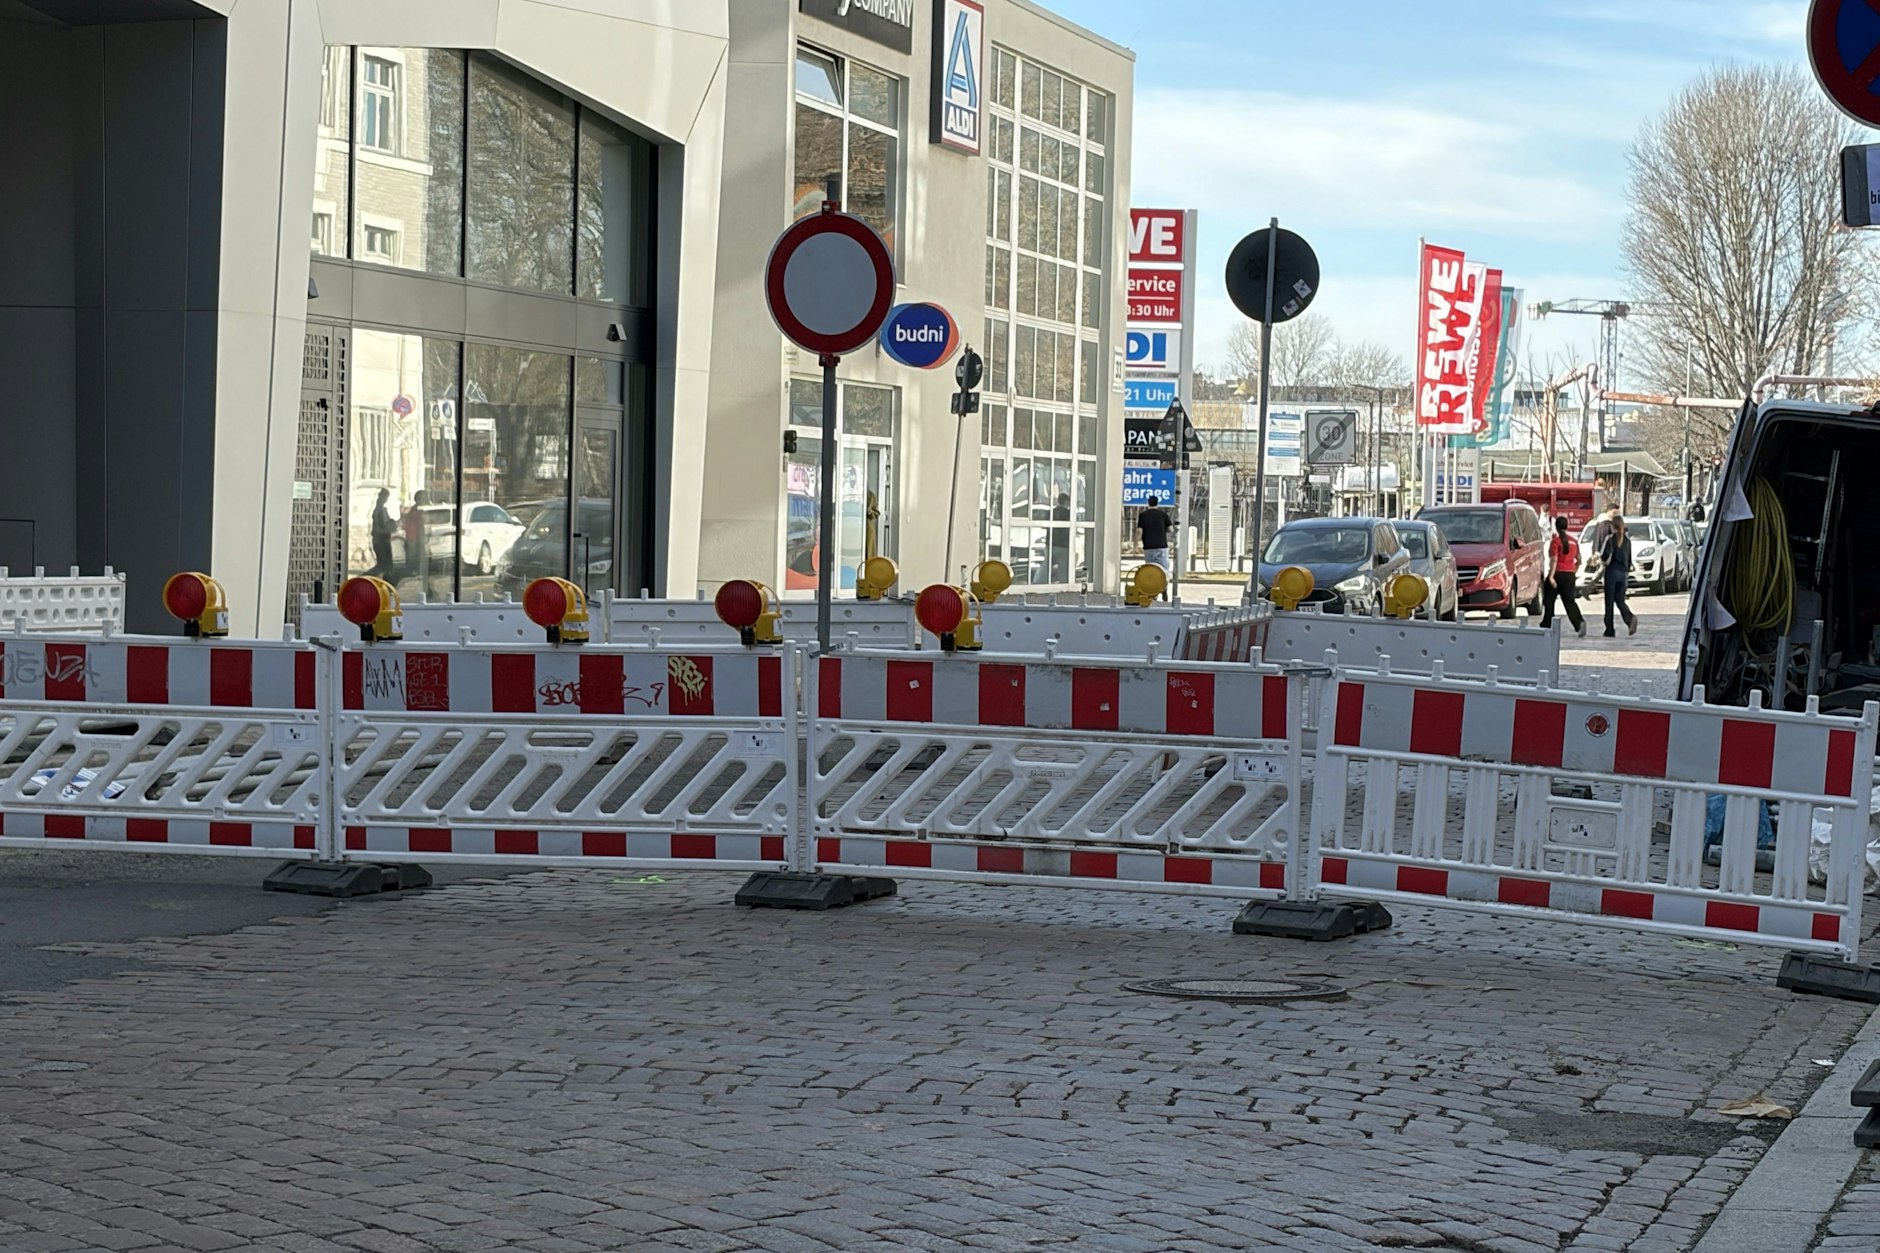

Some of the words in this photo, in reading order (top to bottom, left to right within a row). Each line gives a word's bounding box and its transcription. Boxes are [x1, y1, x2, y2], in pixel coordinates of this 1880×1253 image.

[947, 105, 974, 138] ALDI
[1154, 305, 1175, 316] Uhr
[895, 323, 944, 342] budni
[1124, 388, 1140, 400] 21
[1145, 389, 1173, 401] Uhr
[1321, 425, 1340, 441] 30
[1320, 452, 1343, 461] ZONE
